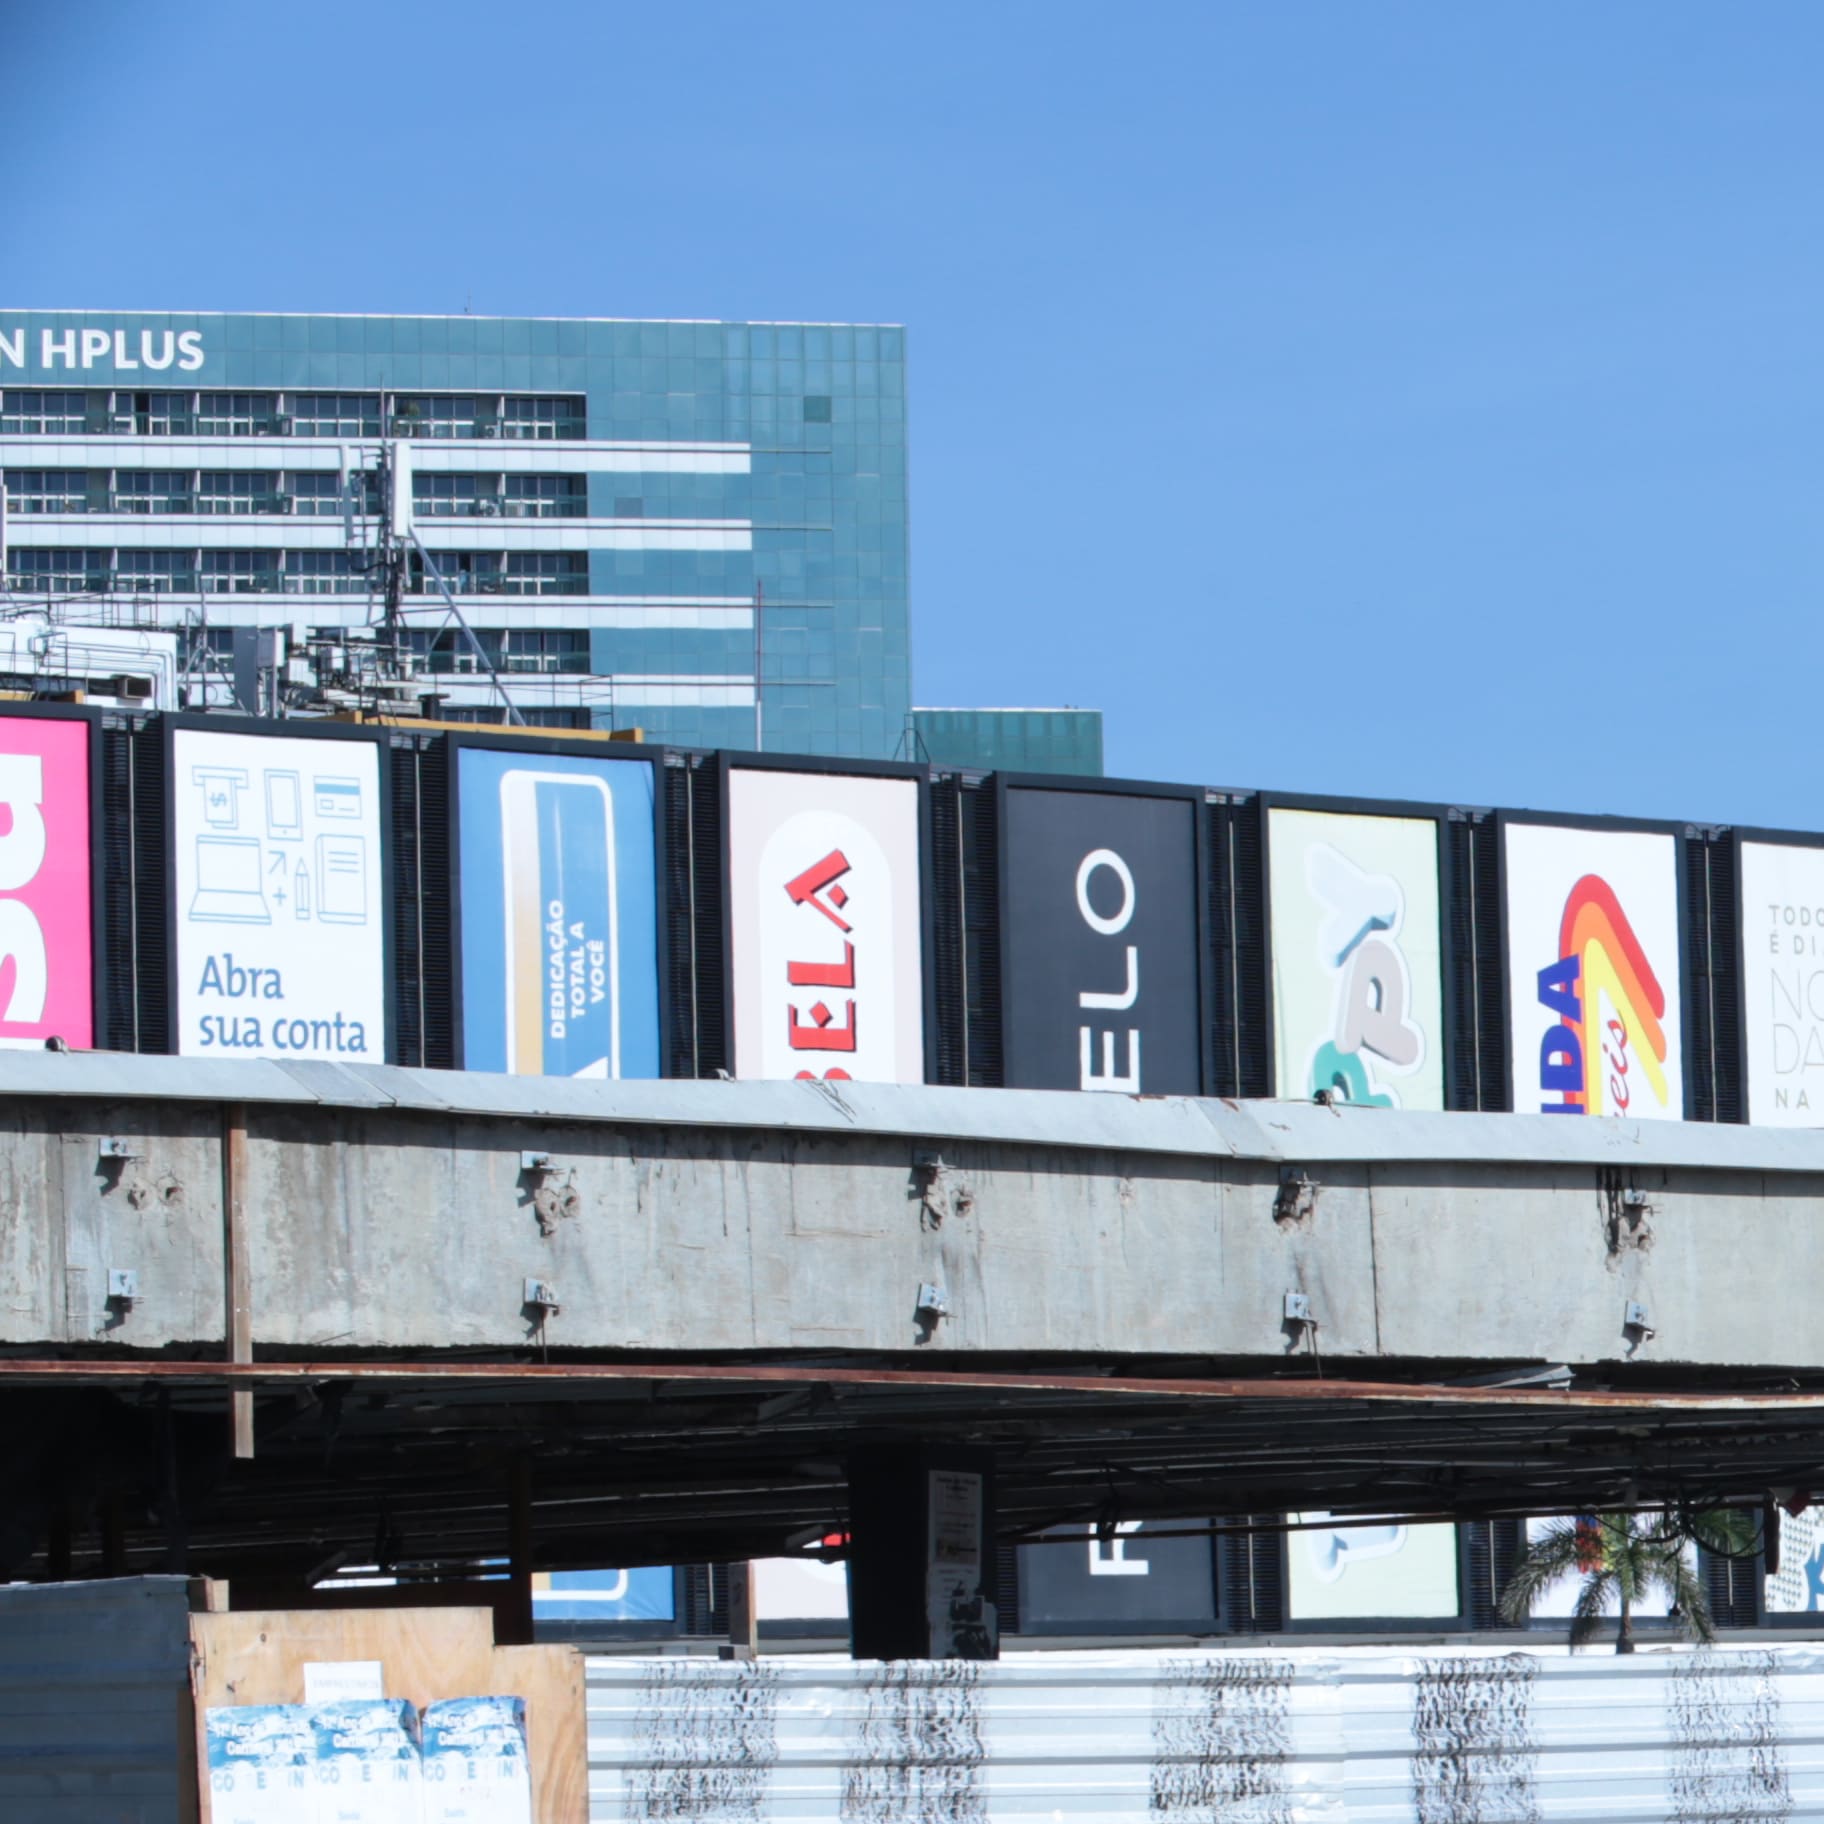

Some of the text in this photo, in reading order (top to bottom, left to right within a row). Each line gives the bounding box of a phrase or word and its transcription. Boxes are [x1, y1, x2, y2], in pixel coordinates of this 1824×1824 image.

[41, 328, 205, 371] HPLUS
[1768, 930, 1780, 955] É
[197, 952, 285, 999] Abra
[546, 899, 568, 1039] DEDICAÇÃO
[570, 921, 586, 1019] TOTAL A
[586, 939, 606, 1004] VOCÊ
[198, 1011, 368, 1053] sua conta
[1774, 1087, 1811, 1111] NA
